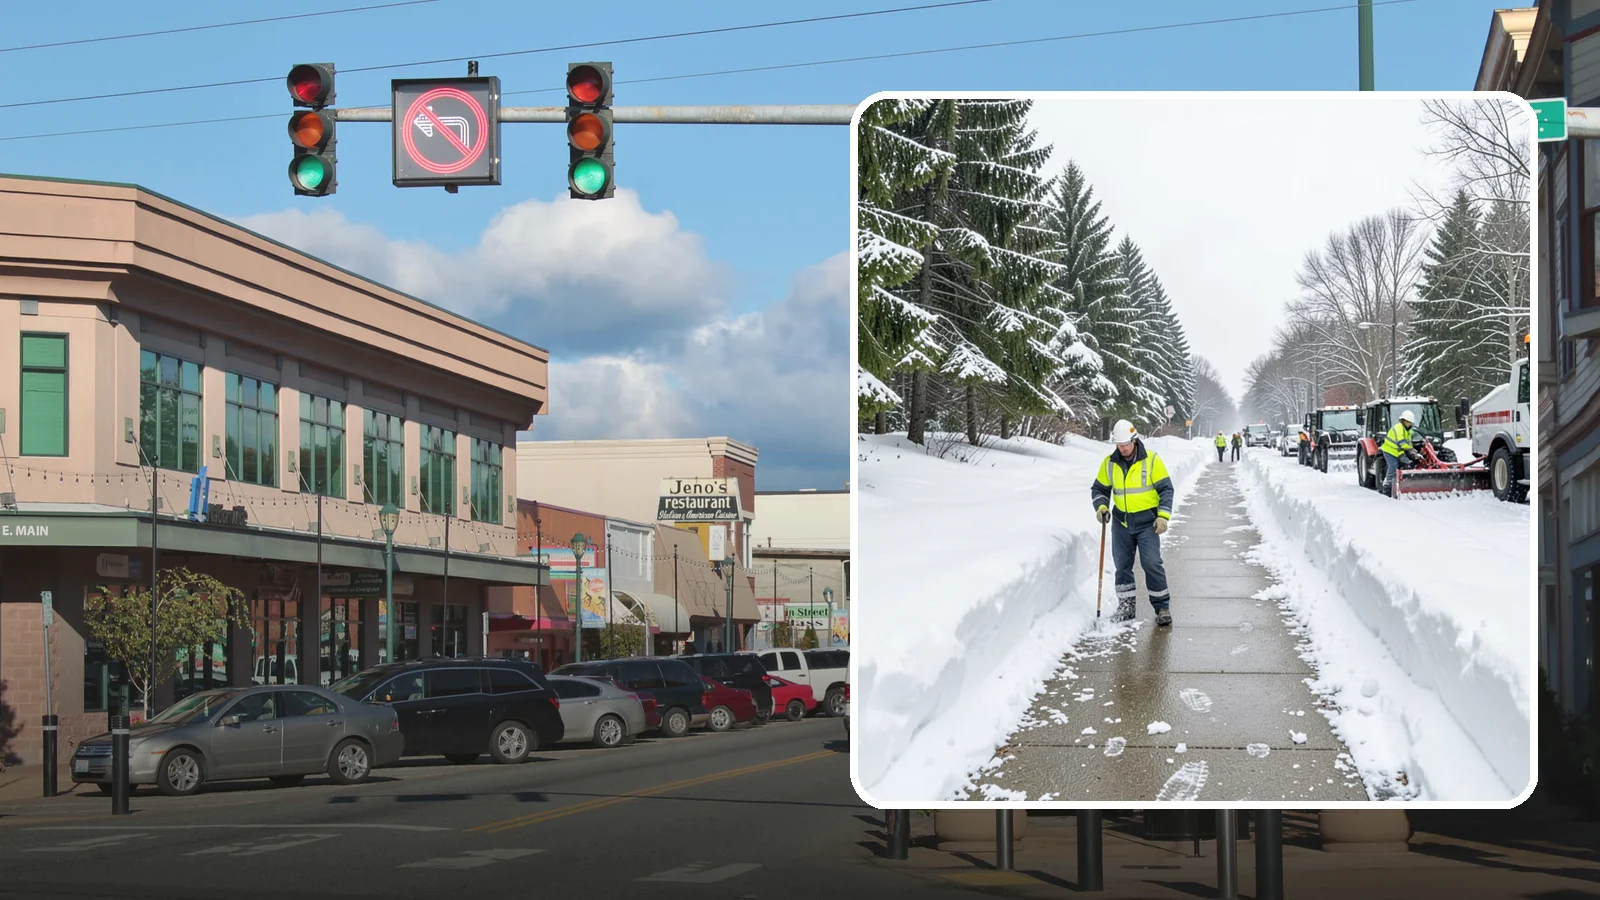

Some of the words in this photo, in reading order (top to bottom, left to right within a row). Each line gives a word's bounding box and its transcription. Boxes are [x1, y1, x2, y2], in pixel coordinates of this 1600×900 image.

[669, 480, 728, 495] Jeno's
[665, 496, 731, 509] restaurant
[658, 510, 681, 519] Italian
[686, 509, 714, 519] American
[714, 509, 738, 519] Cuisine
[2, 525, 13, 536] E.
[15, 525, 49, 536] MAIN
[797, 607, 828, 617] Street
